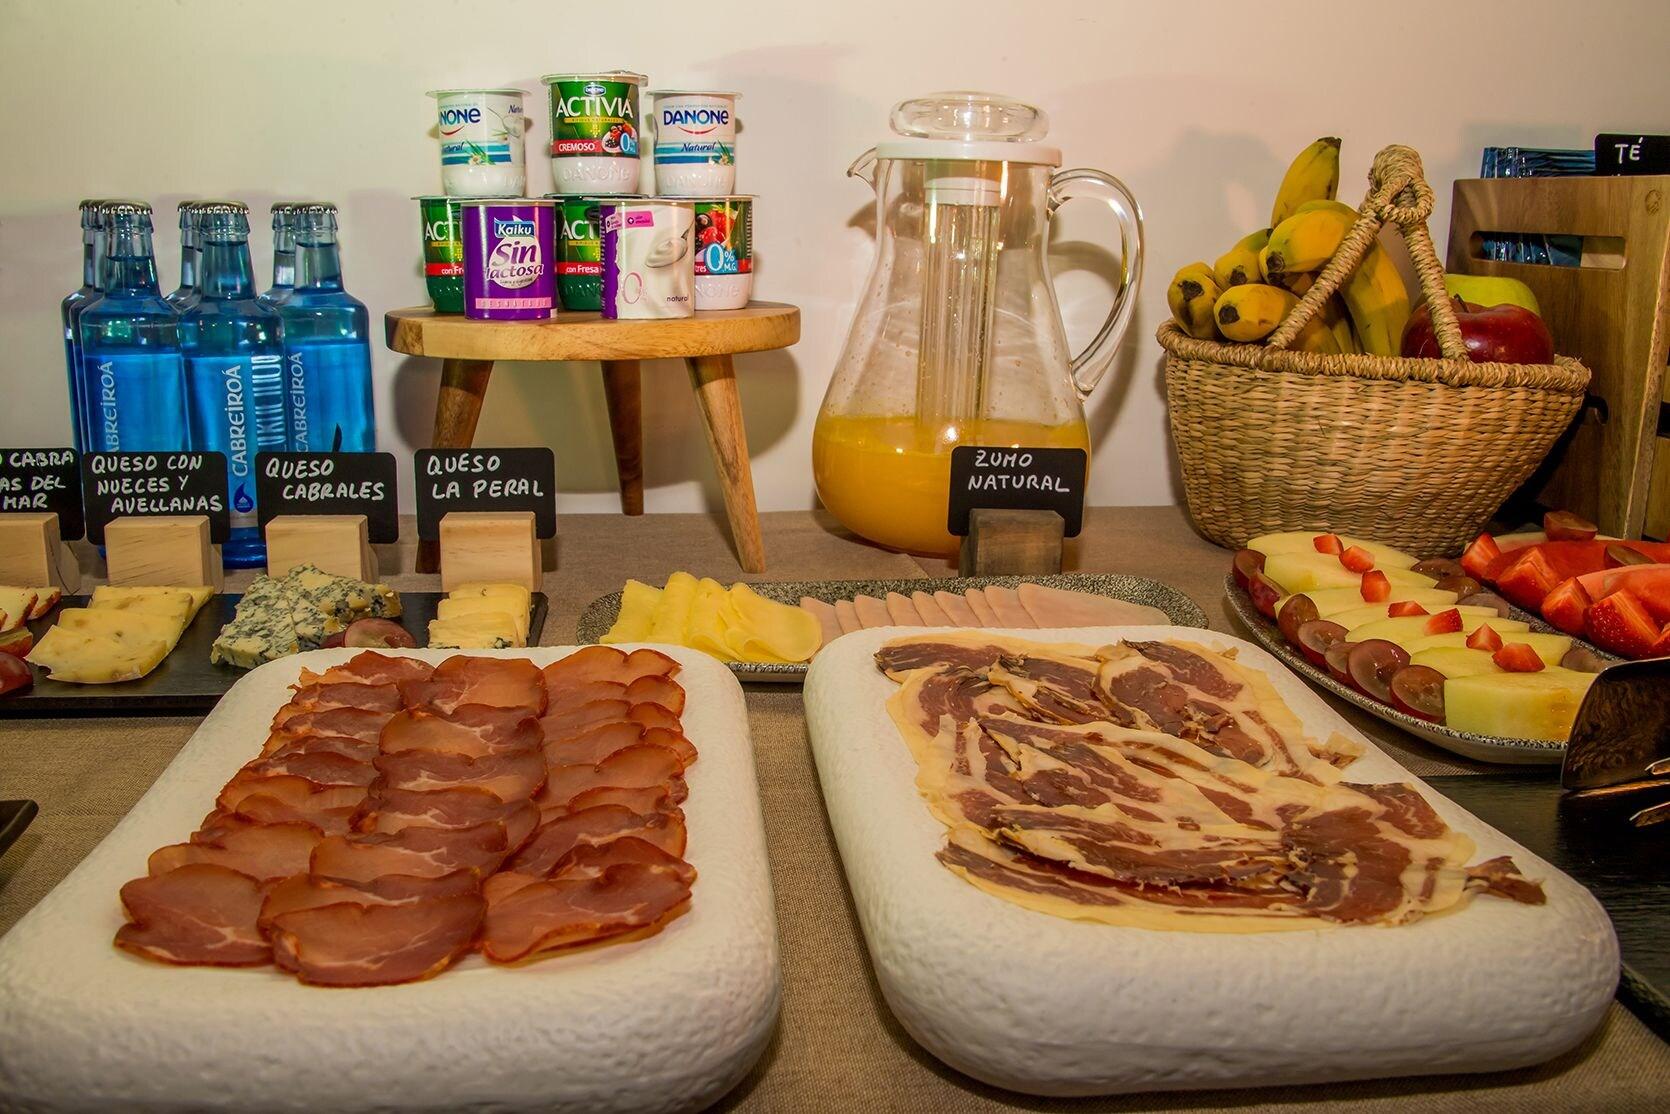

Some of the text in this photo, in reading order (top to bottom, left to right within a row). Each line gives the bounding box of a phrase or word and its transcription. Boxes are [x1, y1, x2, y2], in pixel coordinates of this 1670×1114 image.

[556, 96, 634, 118] ACTIVIA
[663, 109, 730, 126] DANONE
[558, 142, 596, 153] CREMOSO
[680, 141, 717, 153] Natural
[1614, 136, 1644, 164] TÉ
[497, 223, 532, 236] Kaiku
[492, 240, 538, 267] Sin
[441, 268, 453, 276] con
[485, 263, 544, 281] lactosa
[577, 265, 600, 274] Fresa
[9, 450, 74, 468] CABRA
[91, 454, 203, 475] QUESO CON
[265, 457, 334, 479] QUESO
[426, 453, 501, 476] QUESO
[974, 449, 1033, 468] ZUMO
[31, 474, 67, 491] DEL
[97, 475, 189, 496] NUECES Y
[282, 481, 385, 502] CABRALES
[431, 478, 544, 500] LA PERAL
[968, 474, 1070, 493] NATURAL
[3, 492, 48, 510] MAR
[111, 494, 223, 514] AVELLANAS
